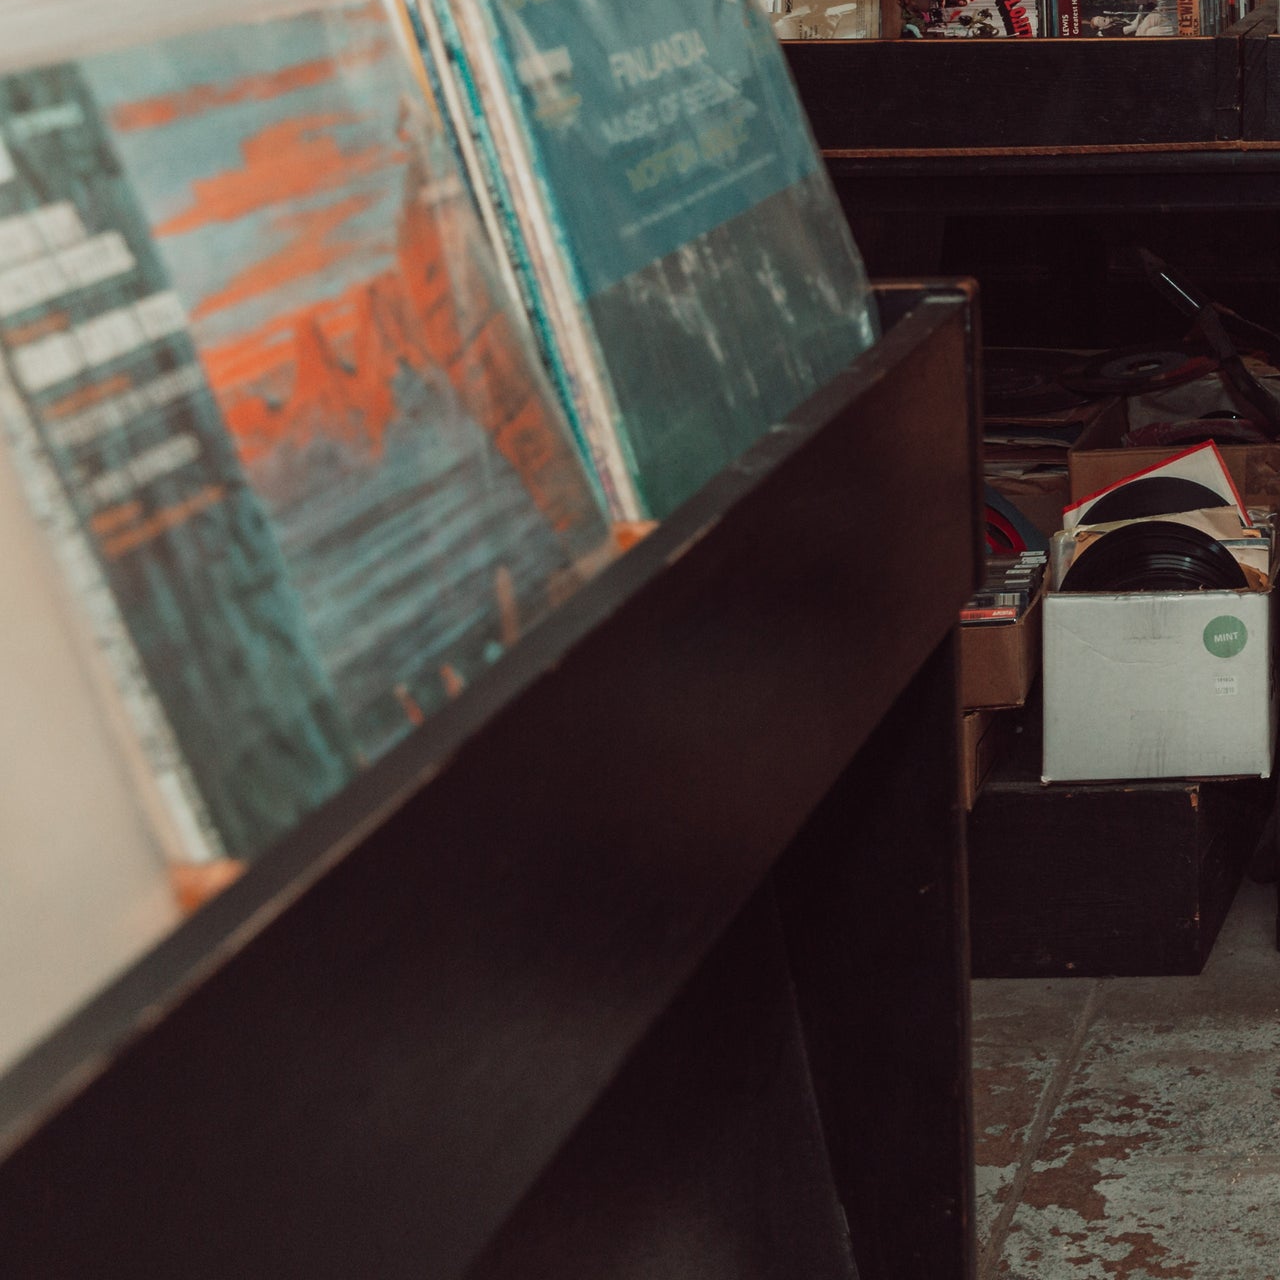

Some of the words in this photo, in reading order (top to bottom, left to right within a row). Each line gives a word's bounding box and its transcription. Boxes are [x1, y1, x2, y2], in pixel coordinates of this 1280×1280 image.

[1062, 14, 1070, 36] LEWIS
[608, 26, 707, 87] FINLANDIA
[1213, 631, 1239, 644] MINT
